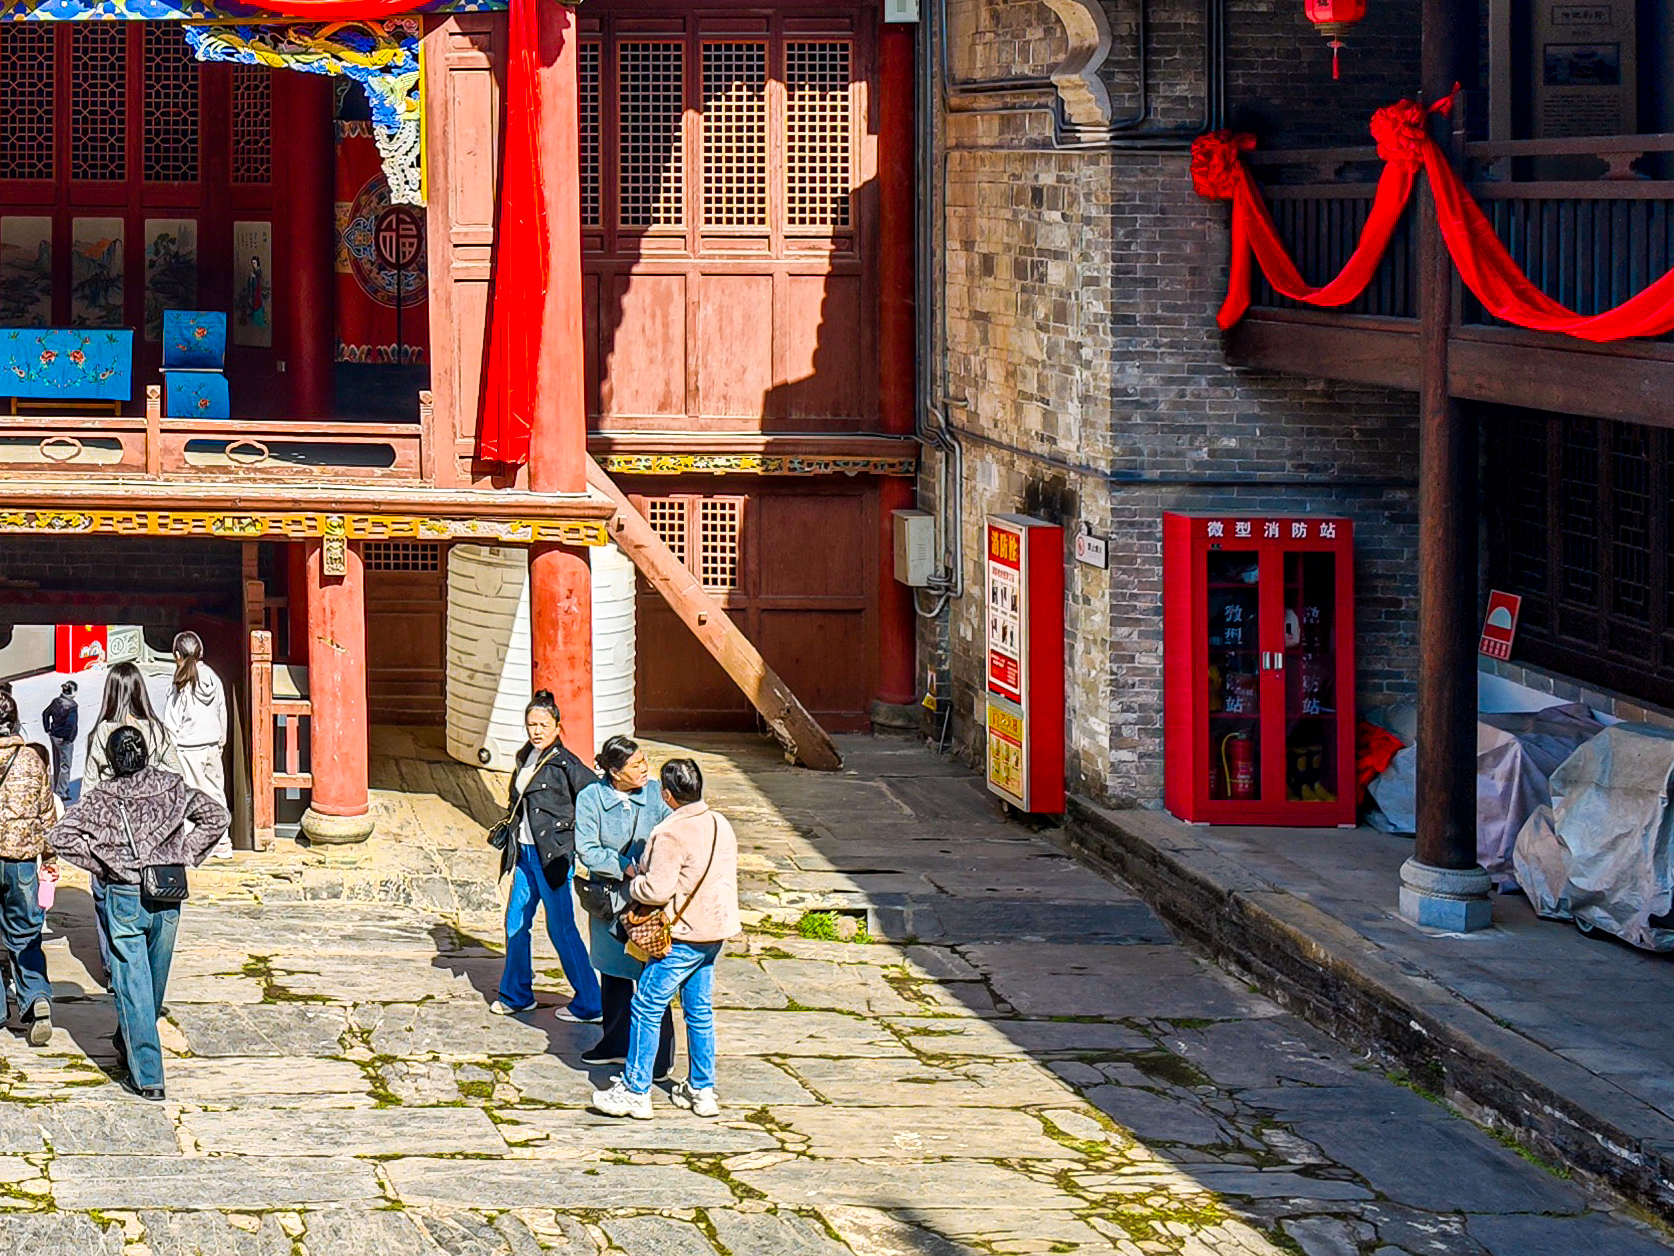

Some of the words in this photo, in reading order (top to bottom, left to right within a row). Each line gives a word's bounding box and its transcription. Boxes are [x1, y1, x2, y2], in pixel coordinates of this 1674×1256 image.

[378, 213, 418, 264] 福
[990, 530, 1019, 562] 消防栓
[1207, 521, 1336, 539] 微型消防站
